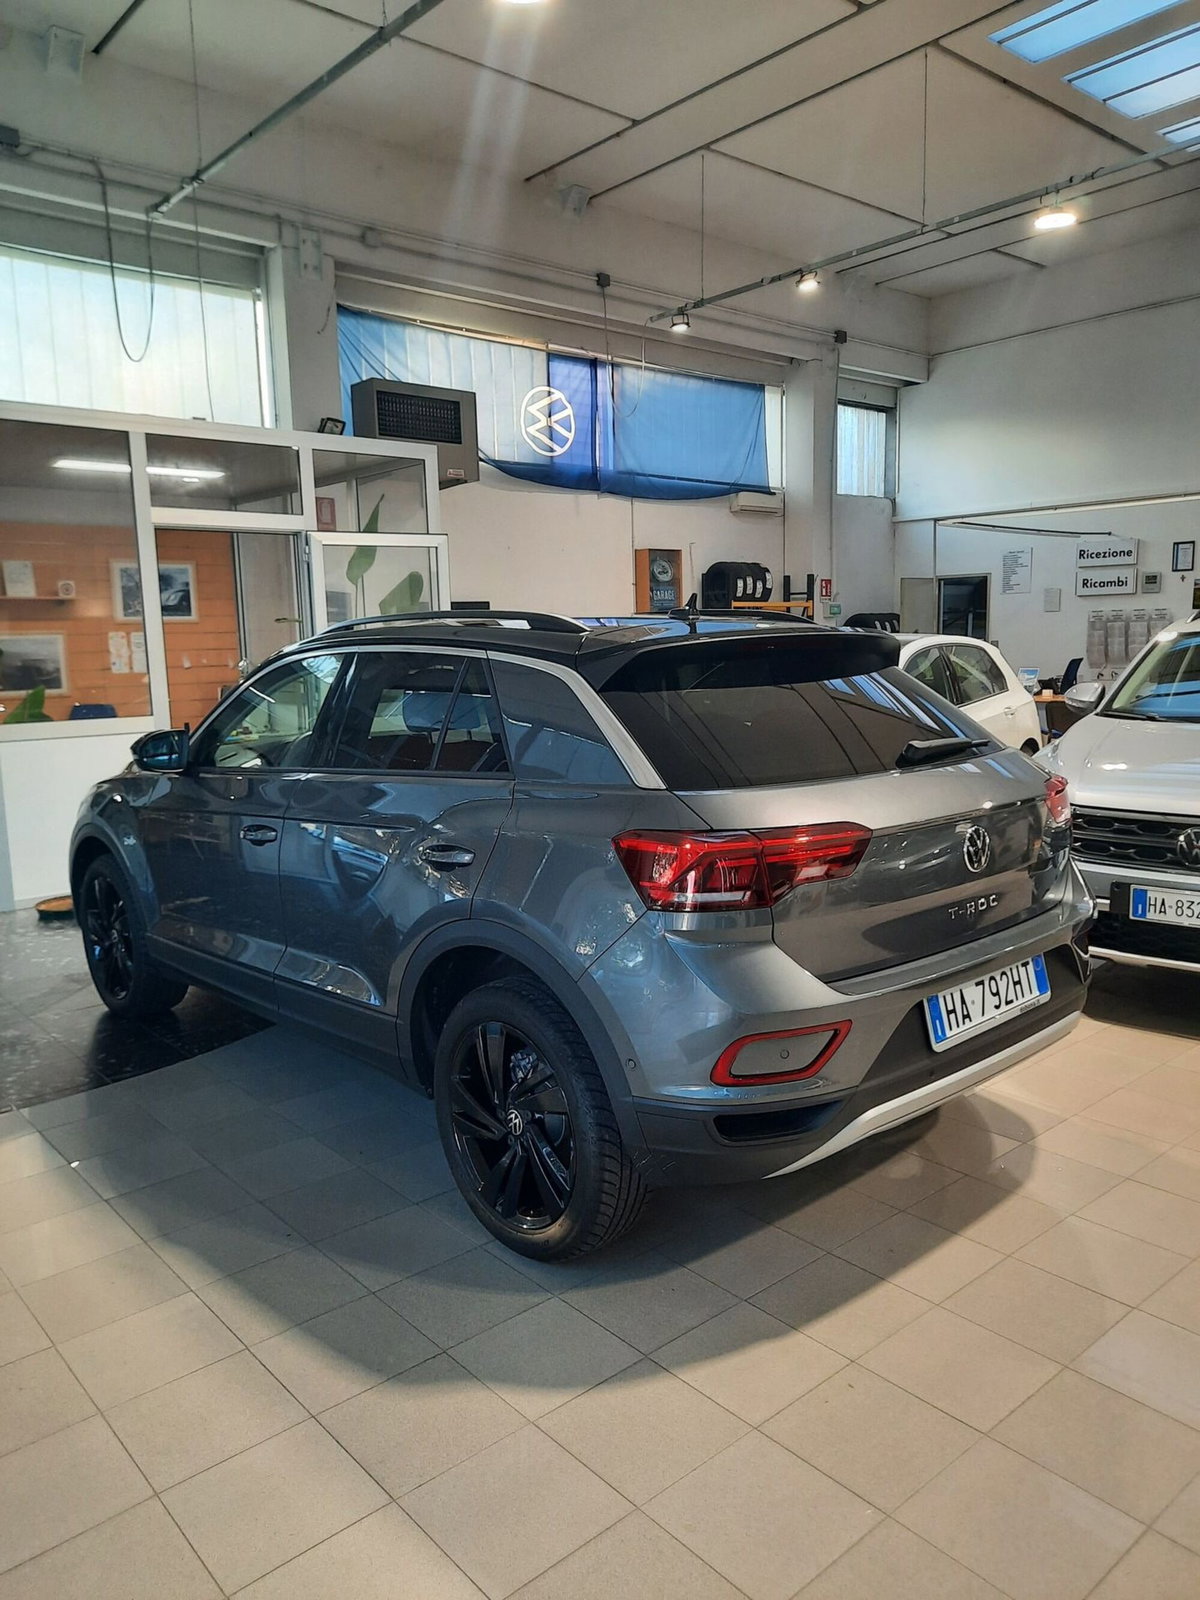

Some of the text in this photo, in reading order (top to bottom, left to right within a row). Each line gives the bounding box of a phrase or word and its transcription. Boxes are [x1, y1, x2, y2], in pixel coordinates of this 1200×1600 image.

[1078, 548, 1133, 560] Ricezione
[1082, 576, 1128, 589] Ricambi
[948, 895, 998, 919] T-ROC
[1148, 895, 1167, 915] HA
[943, 960, 1033, 1031] HA 792HT
